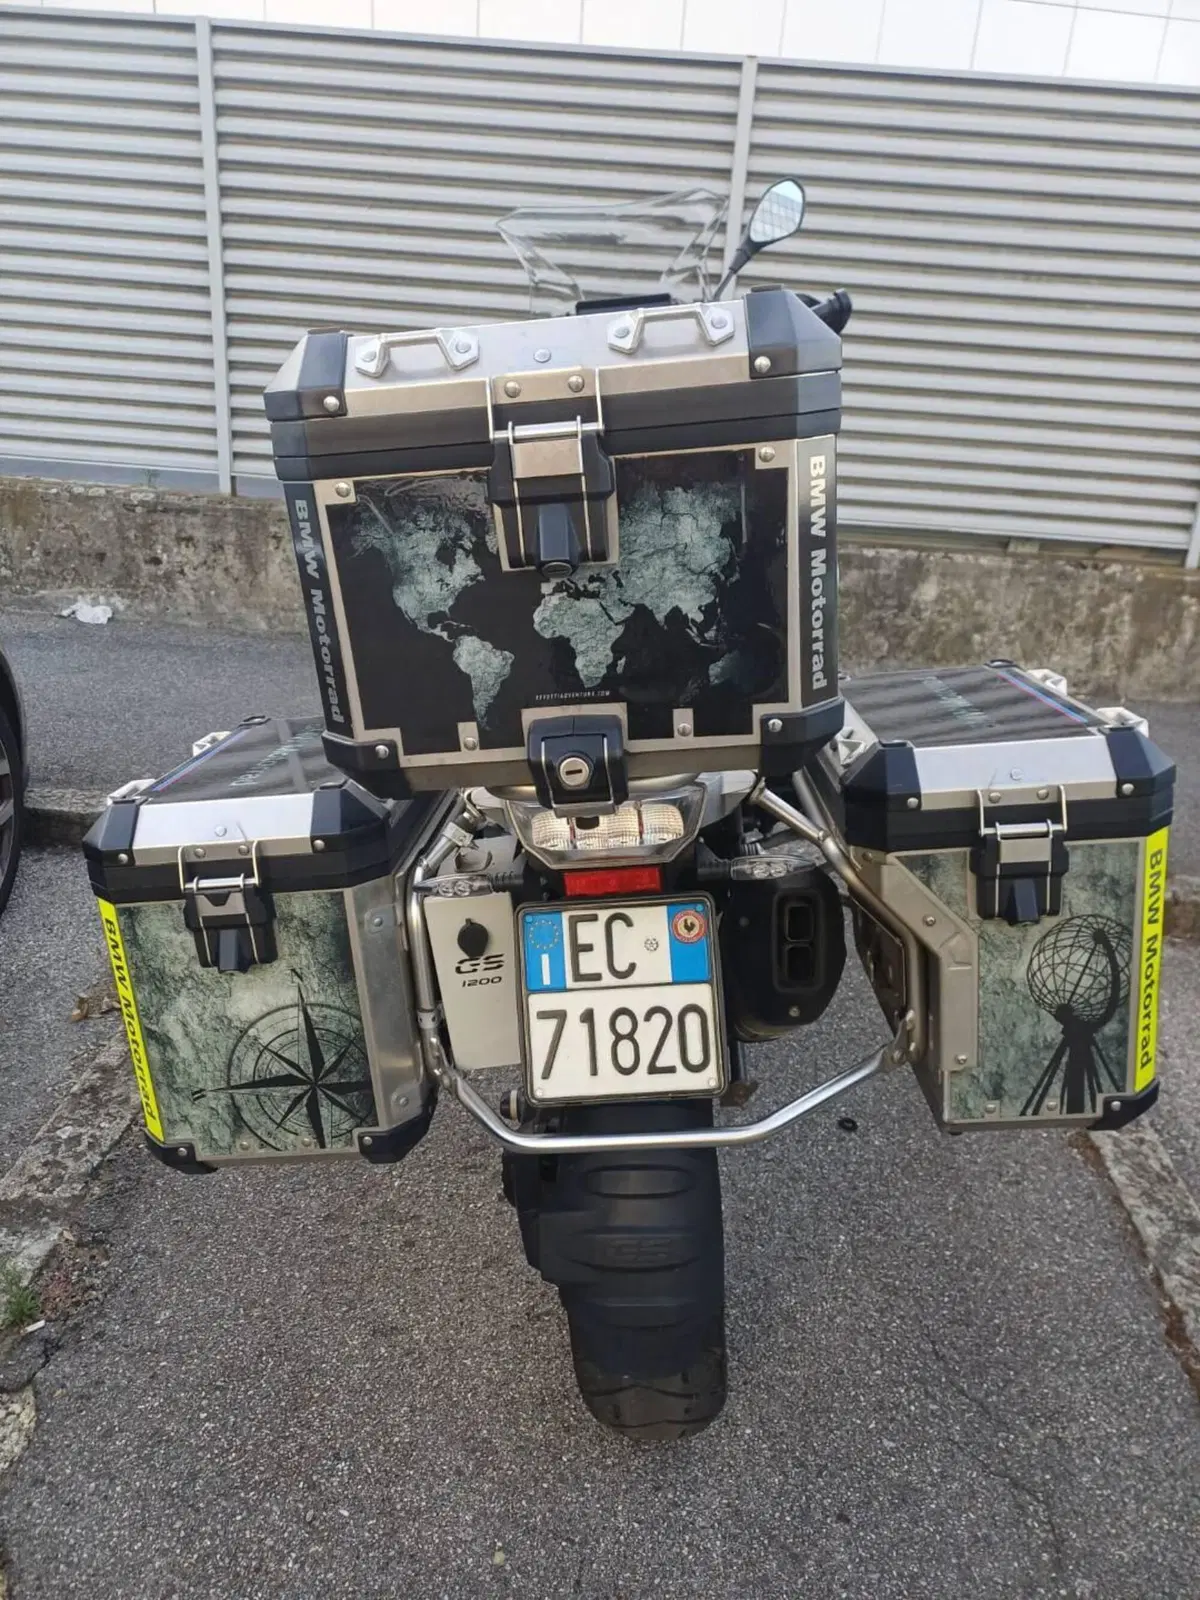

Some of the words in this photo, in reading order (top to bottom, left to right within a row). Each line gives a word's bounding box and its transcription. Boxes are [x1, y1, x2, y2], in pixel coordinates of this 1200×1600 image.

[809, 454, 827, 538] BMW
[295, 499, 321, 580] BMW
[310, 588, 345, 724] Motorrad
[810, 548, 828, 691] Motorrad
[1146, 848, 1164, 926] BMW
[455, 953, 505, 975] GS
[462, 975, 503, 988] 1200
[567, 912, 638, 983] EC
[104, 917, 129, 990] BMW
[121, 995, 156, 1120] Motorrad
[536, 1003, 711, 1080] 71820
[1139, 933, 1159, 1070] Motorrad
